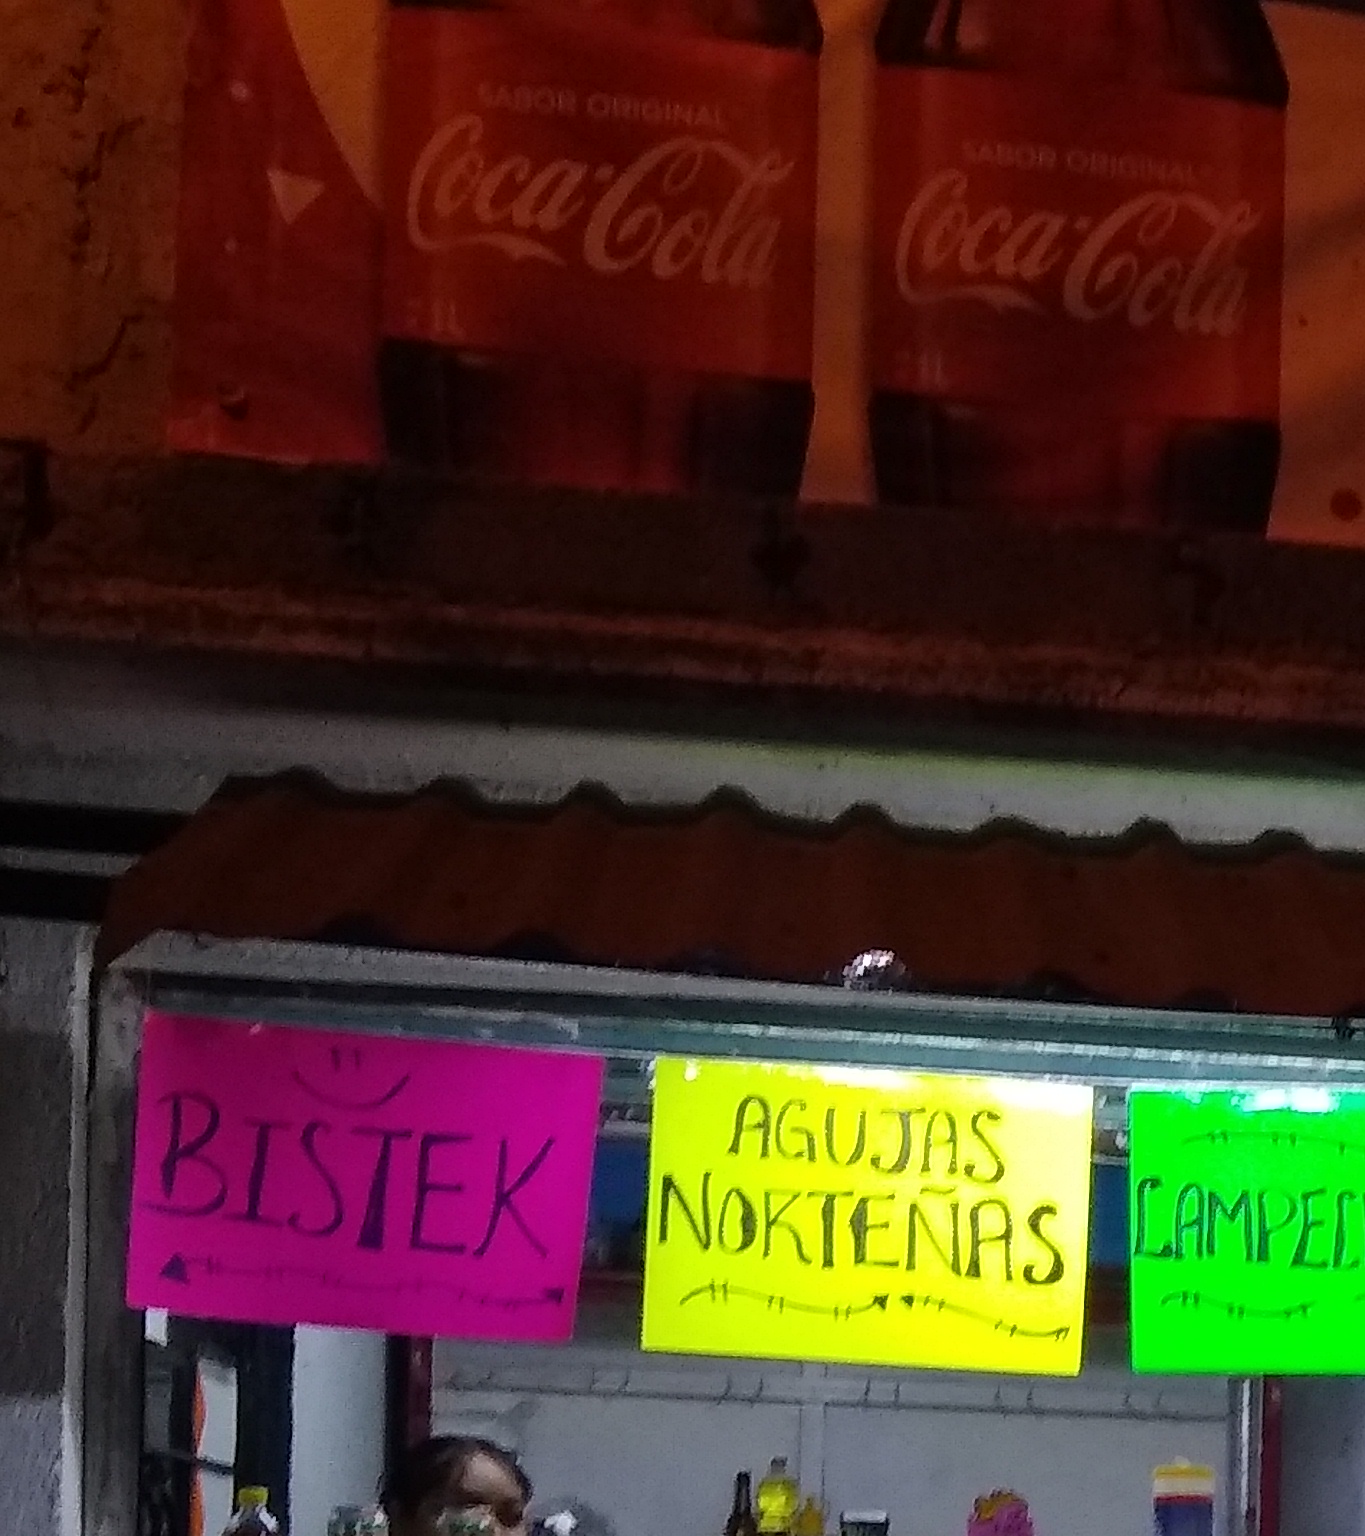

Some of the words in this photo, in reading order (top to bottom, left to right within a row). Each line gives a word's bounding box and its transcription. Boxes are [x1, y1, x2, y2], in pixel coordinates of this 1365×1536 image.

[587, 93, 726, 129] ORIGINAL
[407, 113, 794, 289] Coca-Cola
[896, 167, 1262, 338] Coca-Cola
[148, 1091, 557, 1260] BISTEK
[727, 1093, 1006, 1185] AGUJAS
[659, 1171, 1066, 1287] NORTEÑAS
